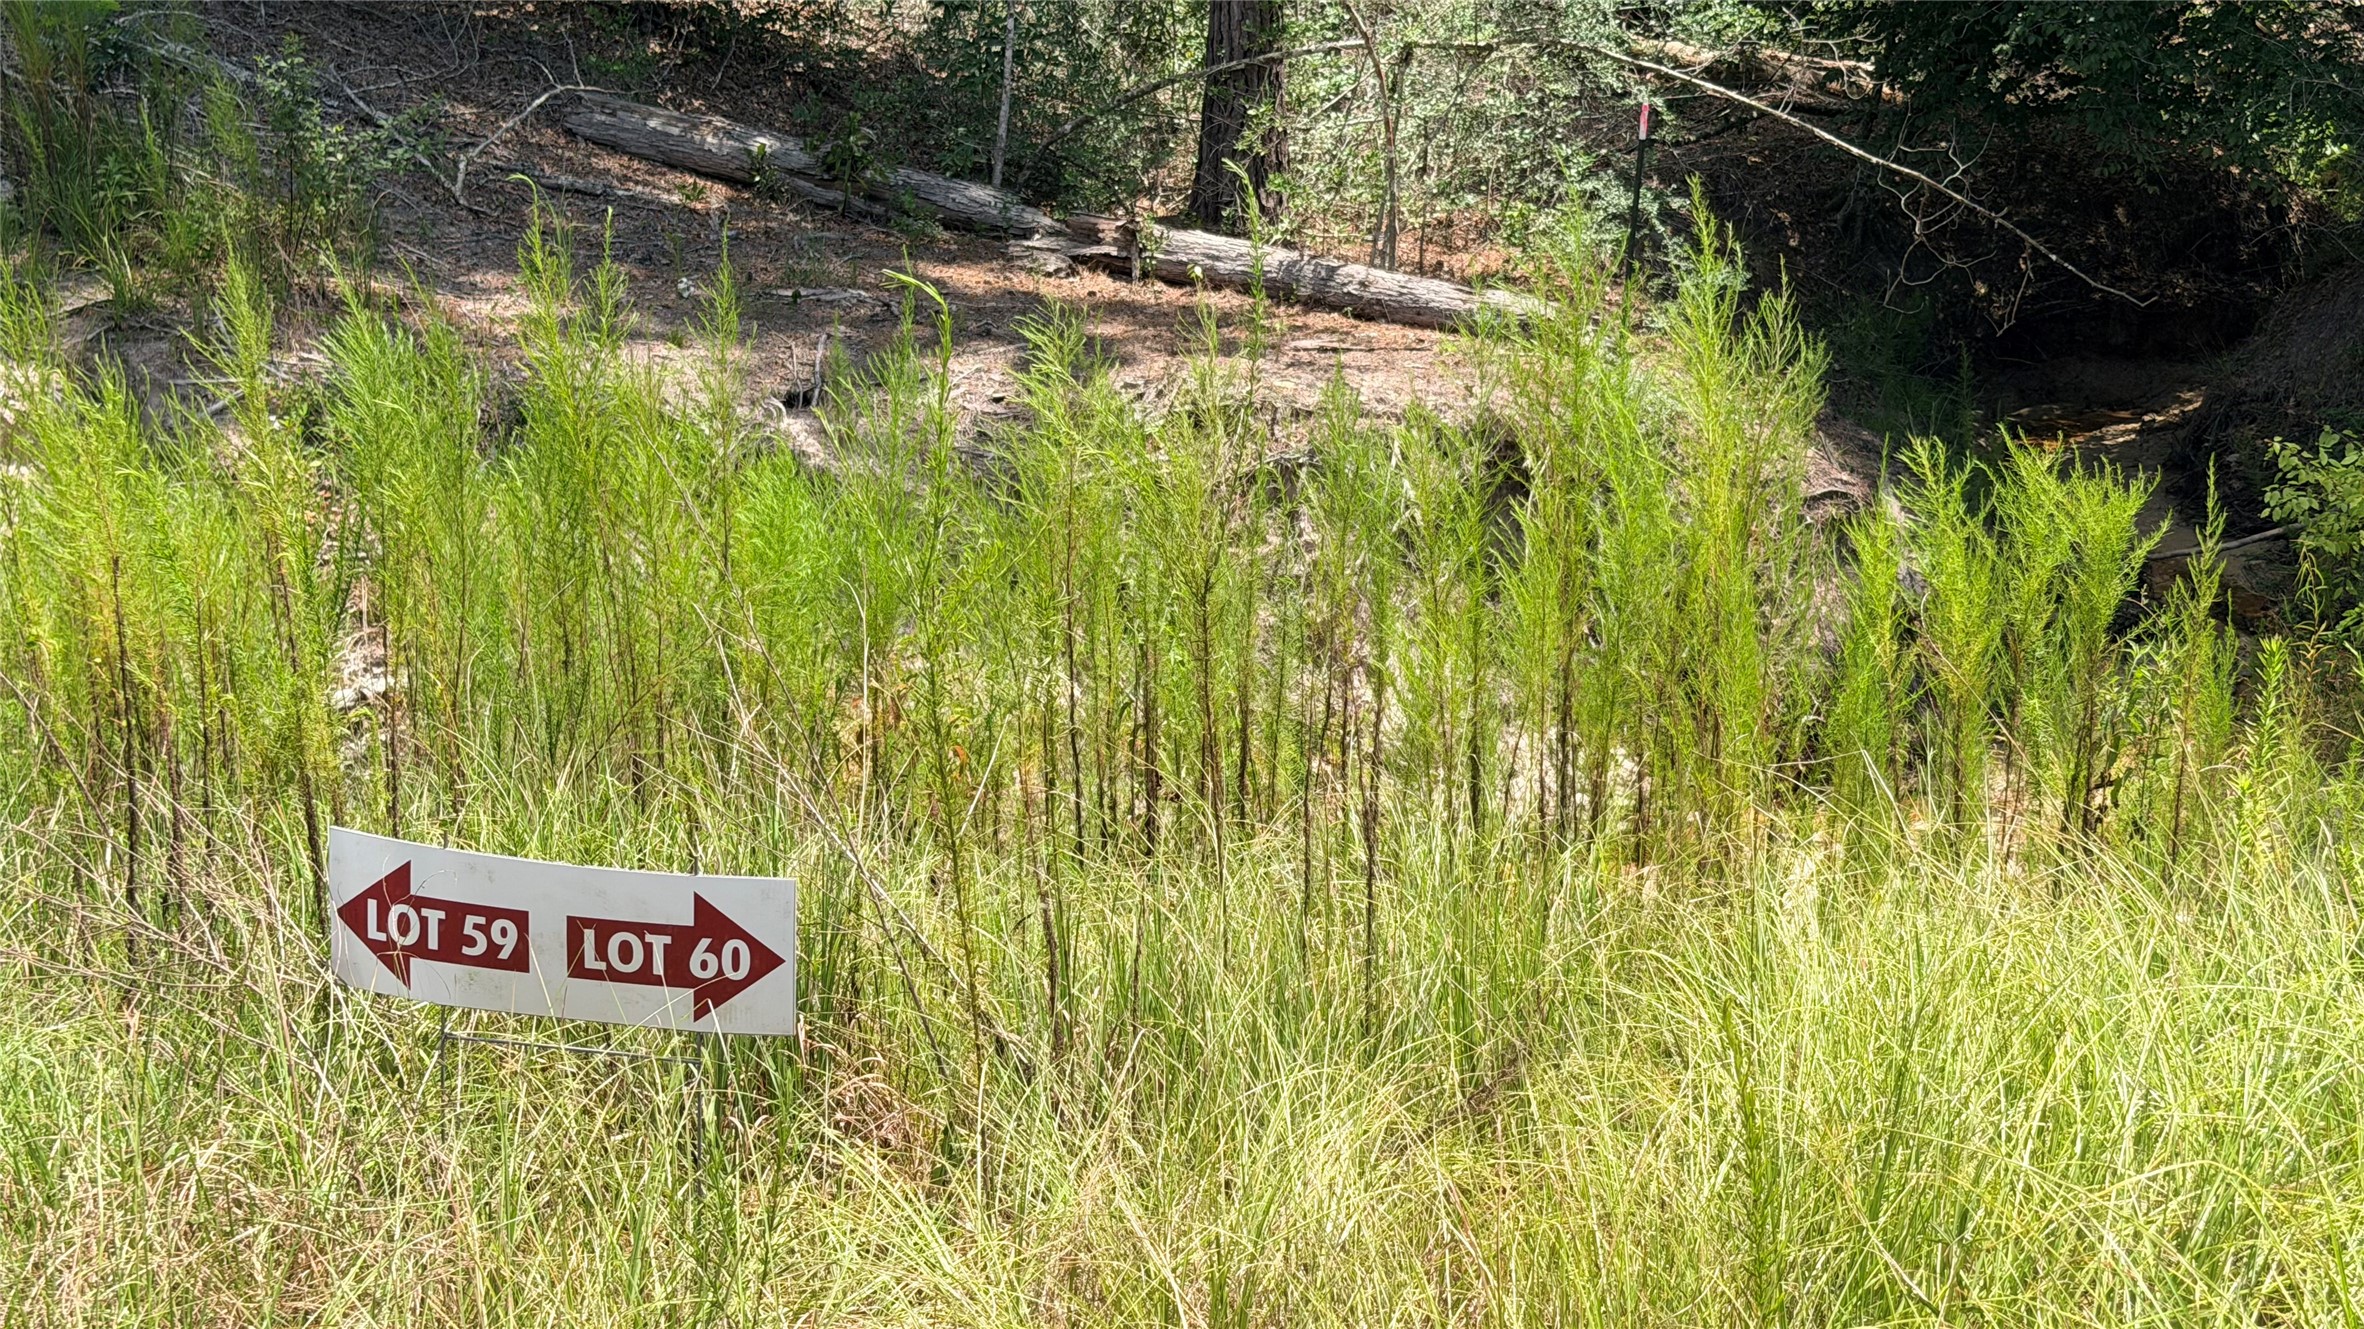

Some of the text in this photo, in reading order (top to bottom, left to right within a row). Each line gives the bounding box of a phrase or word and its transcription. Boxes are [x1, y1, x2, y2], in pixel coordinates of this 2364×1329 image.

[366, 898, 519, 960] LOT 59
[583, 928, 751, 981] LOT 60
